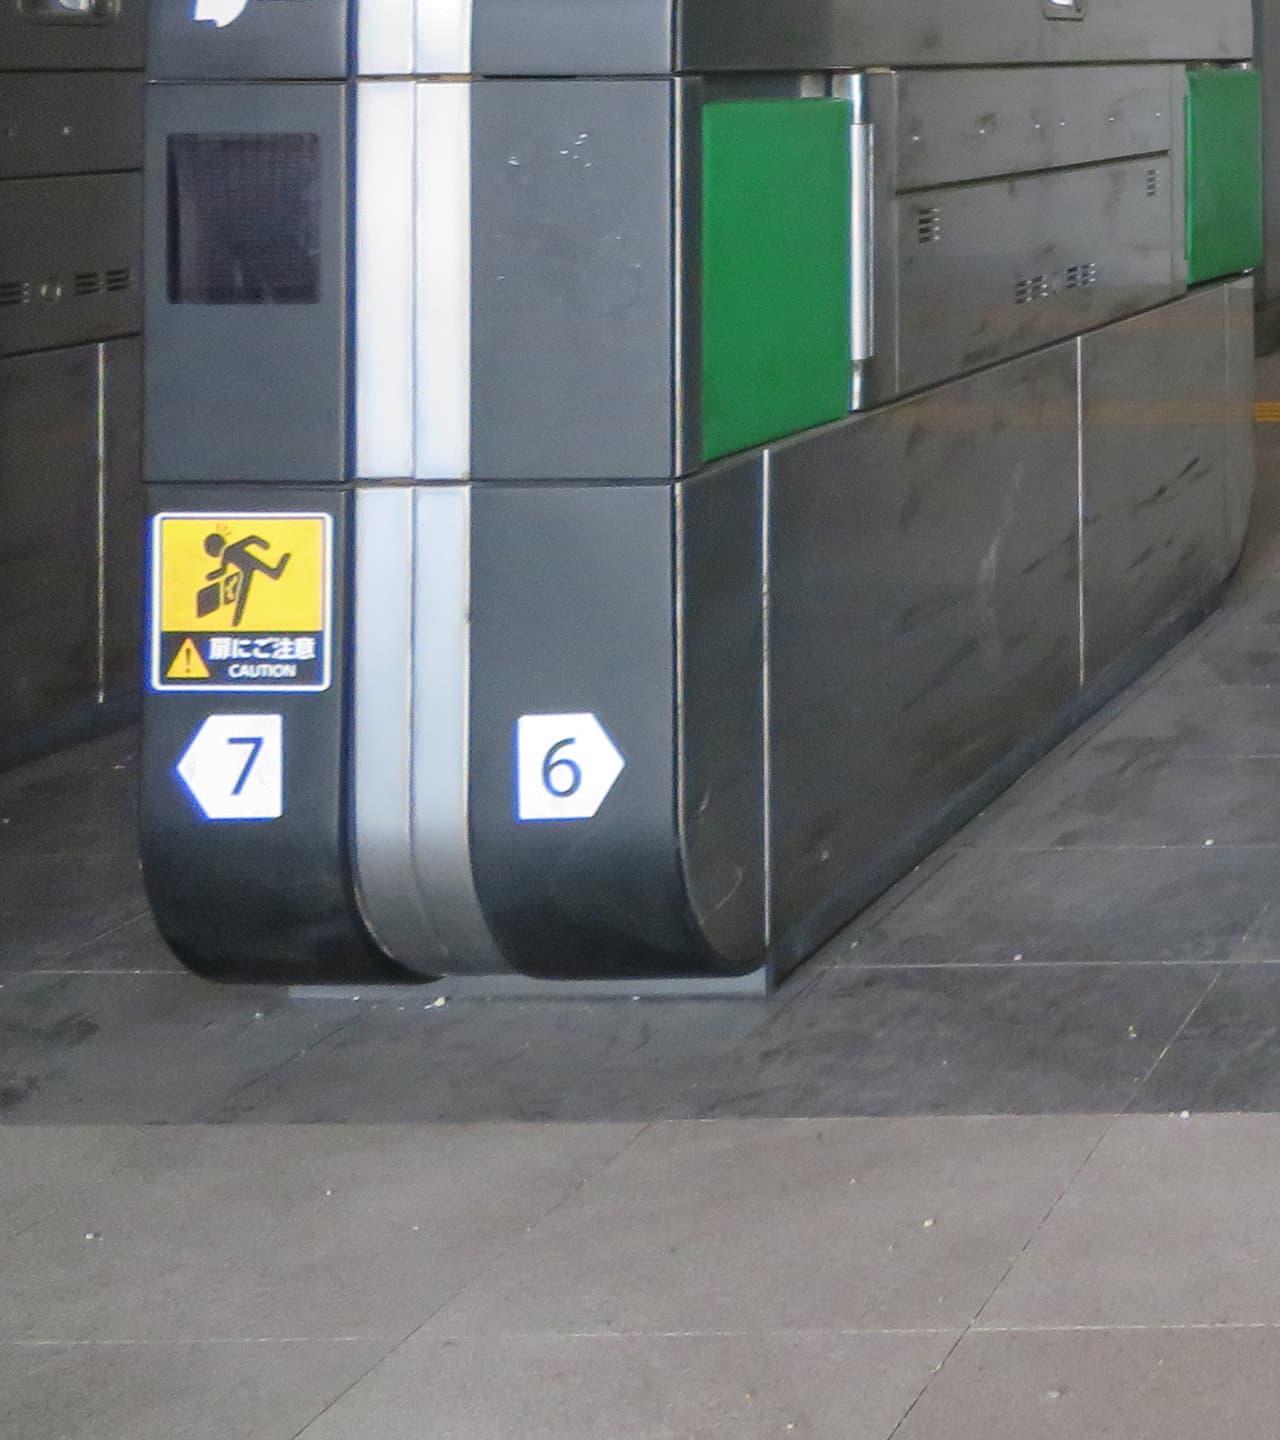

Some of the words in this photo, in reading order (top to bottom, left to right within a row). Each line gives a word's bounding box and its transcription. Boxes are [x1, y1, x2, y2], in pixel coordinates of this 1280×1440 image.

[208, 635, 316, 662] 扉にご注意
[227, 662, 298, 680] CAUTION
[226, 736, 265, 797] 7
[541, 736, 583, 798] 6
